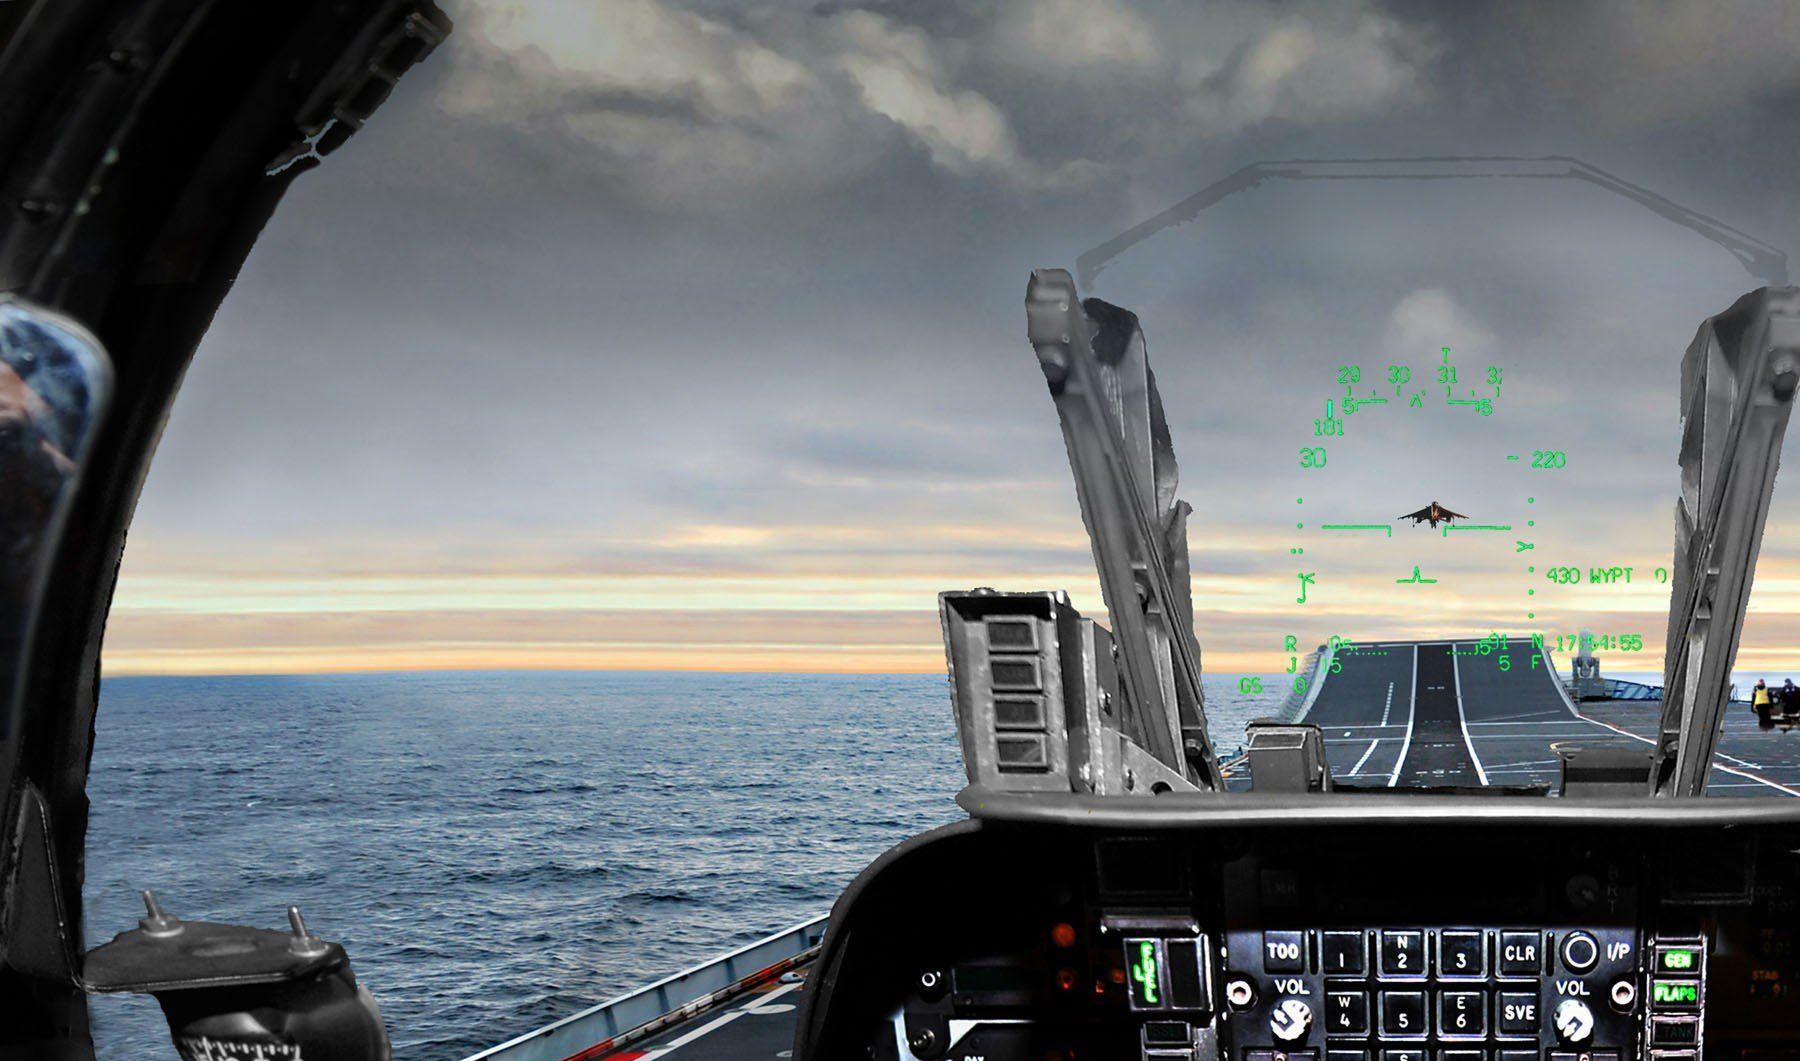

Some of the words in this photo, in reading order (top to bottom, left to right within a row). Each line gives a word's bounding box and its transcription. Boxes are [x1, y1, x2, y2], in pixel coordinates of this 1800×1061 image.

[1337, 365, 1360, 384] 29
[1388, 365, 1411, 384] 30
[1437, 365, 1458, 384] 31
[1313, 419, 1344, 436] 181
[1300, 447, 1327, 468] 30
[1531, 450, 1567, 468] 220
[1546, 567, 1581, 584] 430
[1590, 567, 1633, 584] WYPT
[1284, 635, 1297, 652] R
[1531, 633, 1544, 650] N
[1531, 655, 1542, 670] F
[1237, 677, 1263, 695] GS
[1397, 936, 1408, 949] N
[1505, 945, 1536, 961] CLR
[1607, 942, 1631, 962] I/P
[1398, 953, 1408, 969] 2
[1456, 953, 1467, 969] 3
[1274, 979, 1310, 995] VOL
[1556, 980, 1590, 996] VOL
[1654, 983, 1696, 1002] FLAPS
[1338, 996, 1350, 1008] W
[1457, 996, 1466, 1010] E
[1340, 1013, 1350, 1027] 4
[1399, 1013, 1409, 1028] 5
[1456, 1013, 1466, 1028] 6
[1505, 1005, 1535, 1020] SVE
